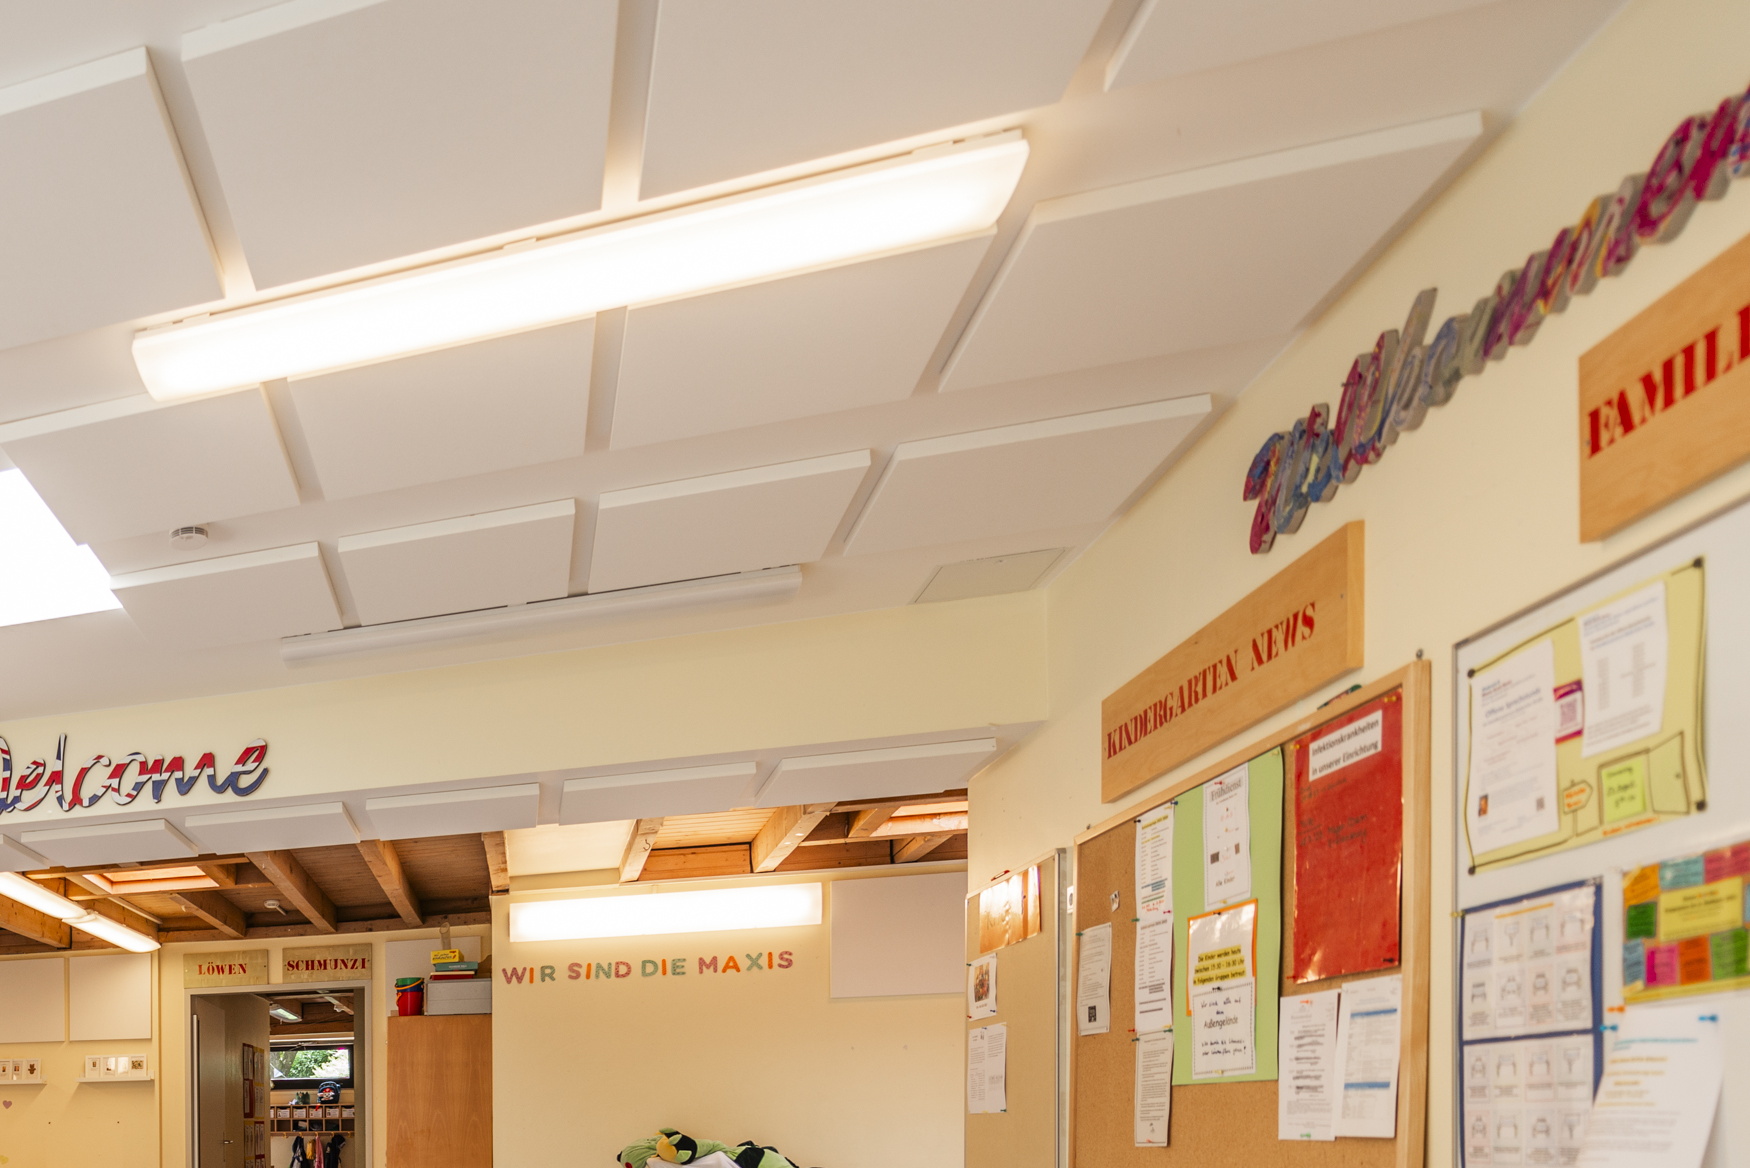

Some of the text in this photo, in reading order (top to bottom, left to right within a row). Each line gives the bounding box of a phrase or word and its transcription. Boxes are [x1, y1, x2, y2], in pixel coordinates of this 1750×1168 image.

[1106, 601, 1316, 760] KINDERGARTEN NEWS
[1312, 719, 1379, 757] Infektionskrankheiten
[1312, 740, 1379, 776] in unserer Einrichtung
[1211, 778, 1242, 802] Frühdienst
[198, 961, 248, 976] LÖWEN
[287, 958, 367, 972] SCHMUNZI
[501, 950, 794, 985] WIR SIND DIE MAXIS
[1204, 1014, 1238, 1030] Außengelände
